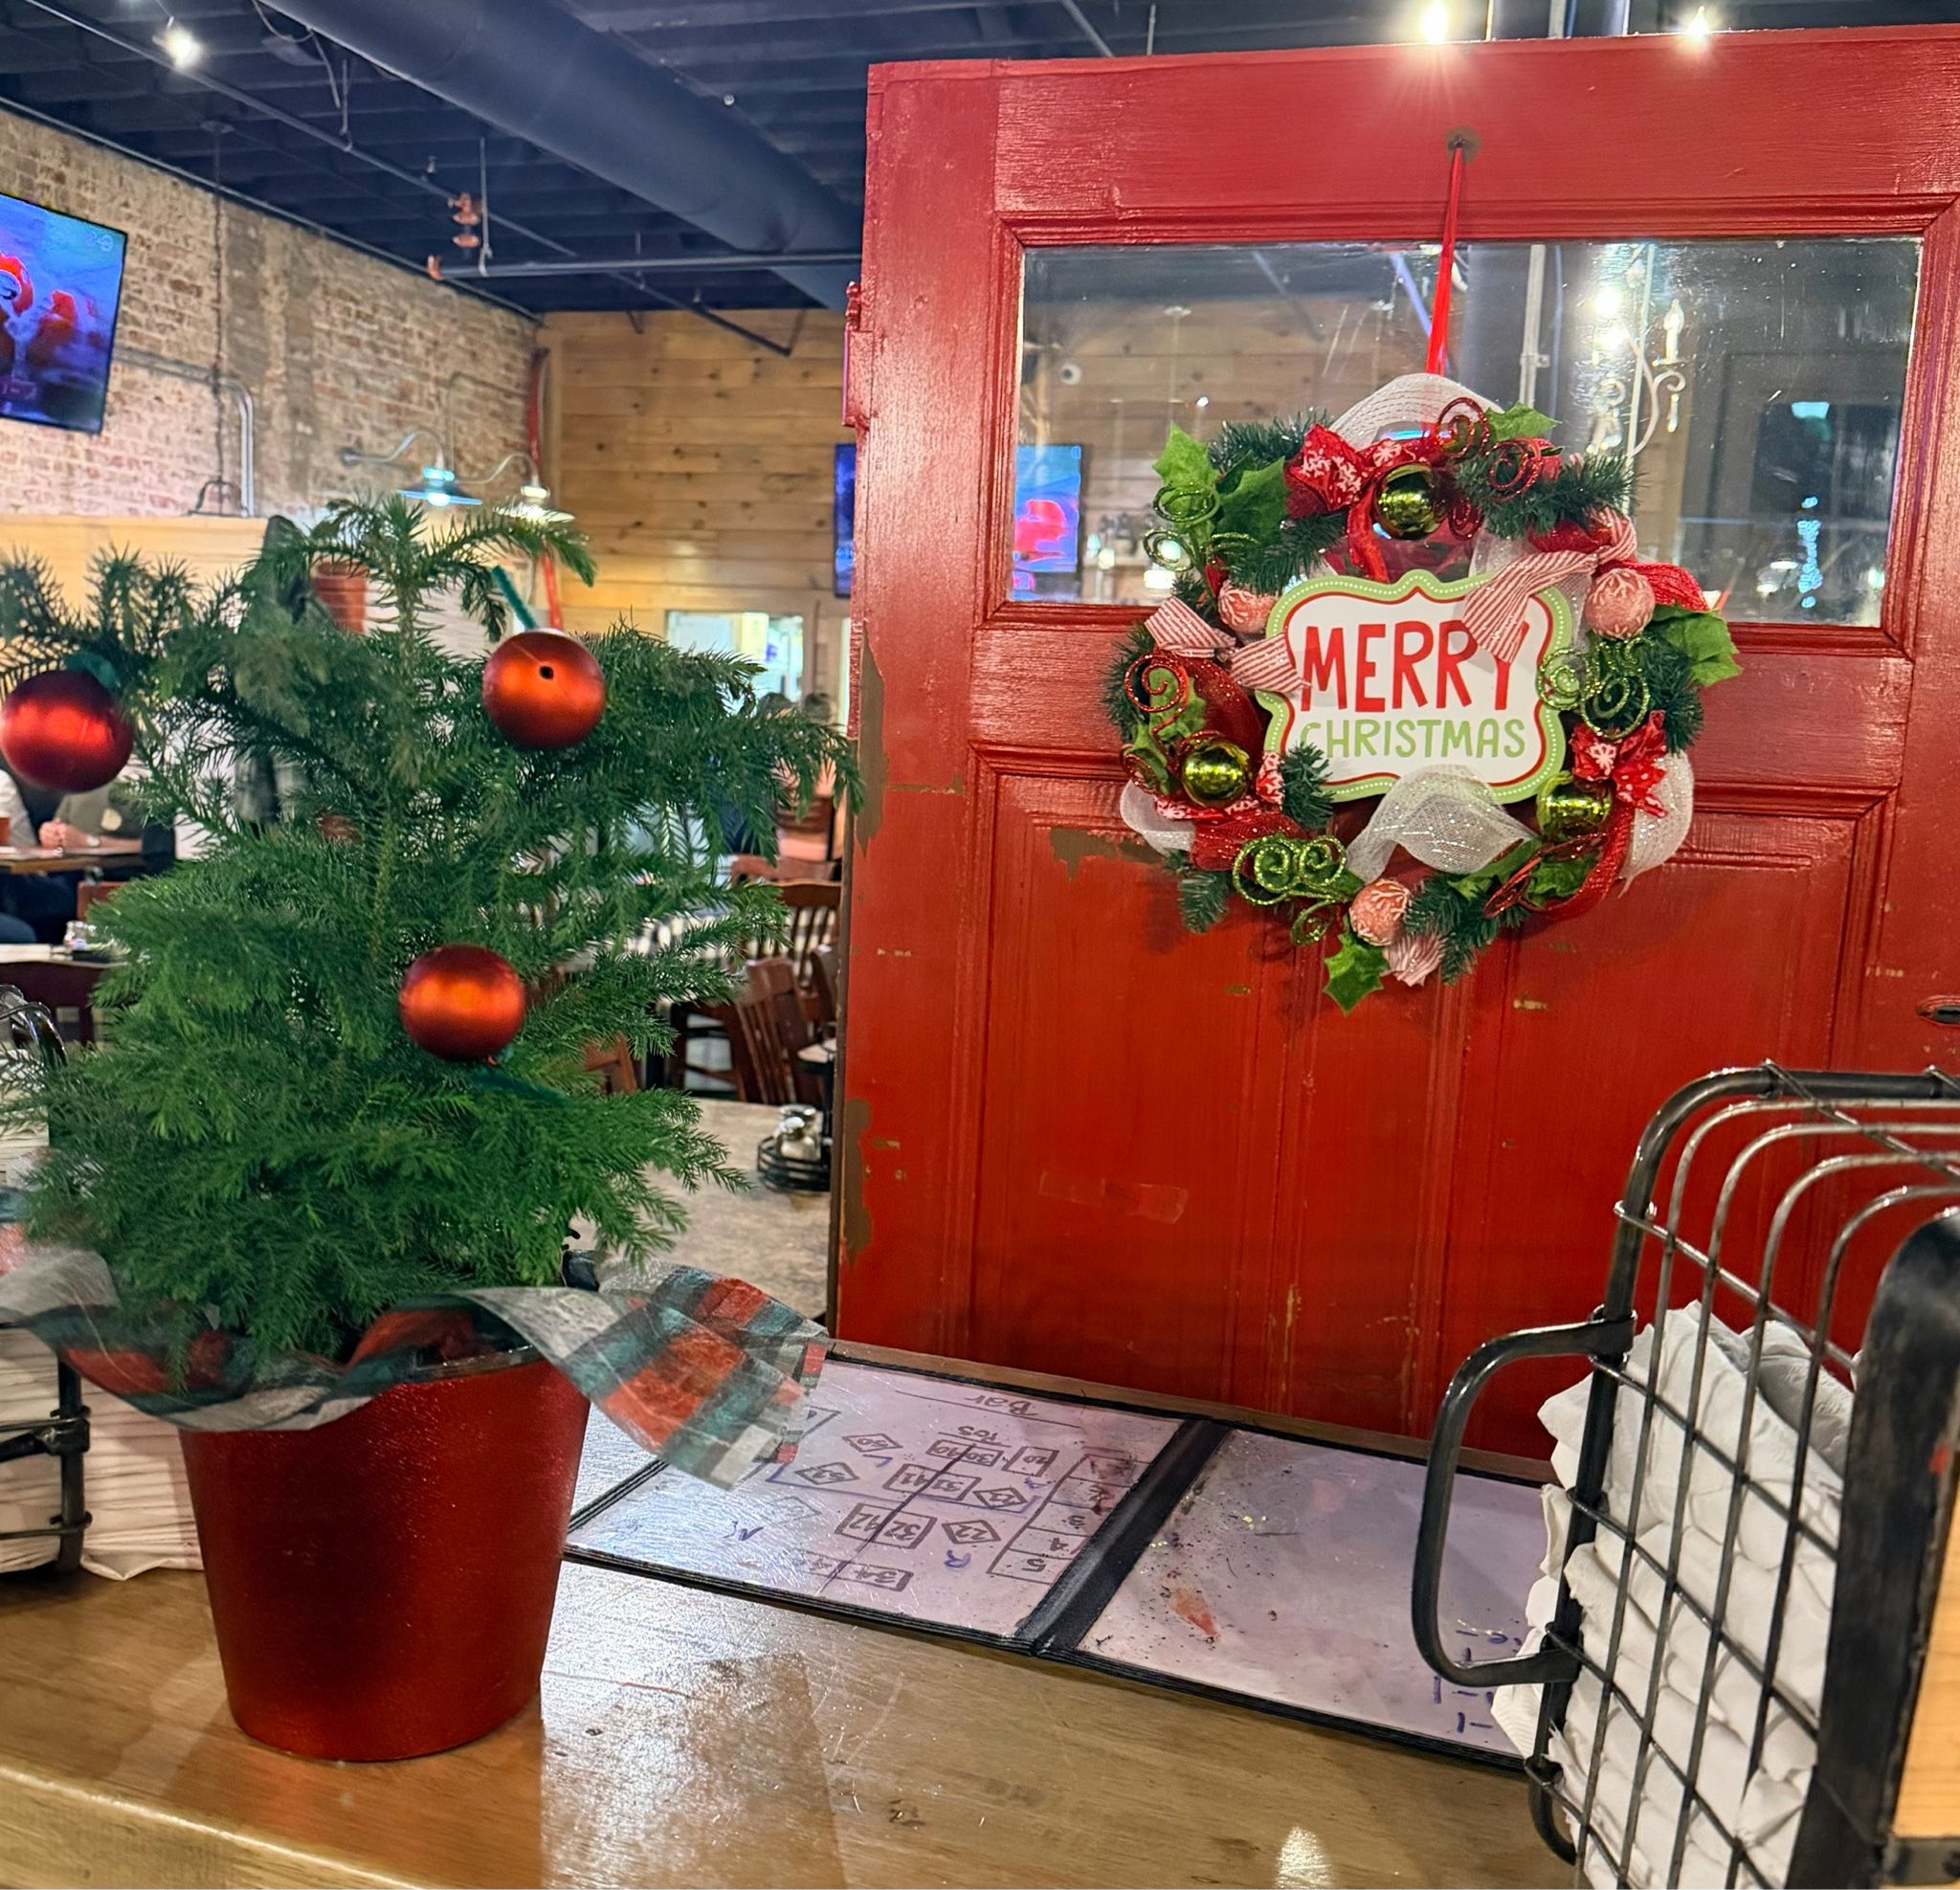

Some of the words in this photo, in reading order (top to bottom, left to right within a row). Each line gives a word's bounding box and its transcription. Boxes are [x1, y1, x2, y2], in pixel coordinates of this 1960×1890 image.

[1301, 620, 1529, 713] MERRY
[965, 1395, 1038, 1416] Bar
[954, 1525, 988, 1541] 22
[1021, 1557, 1047, 1572] 5
